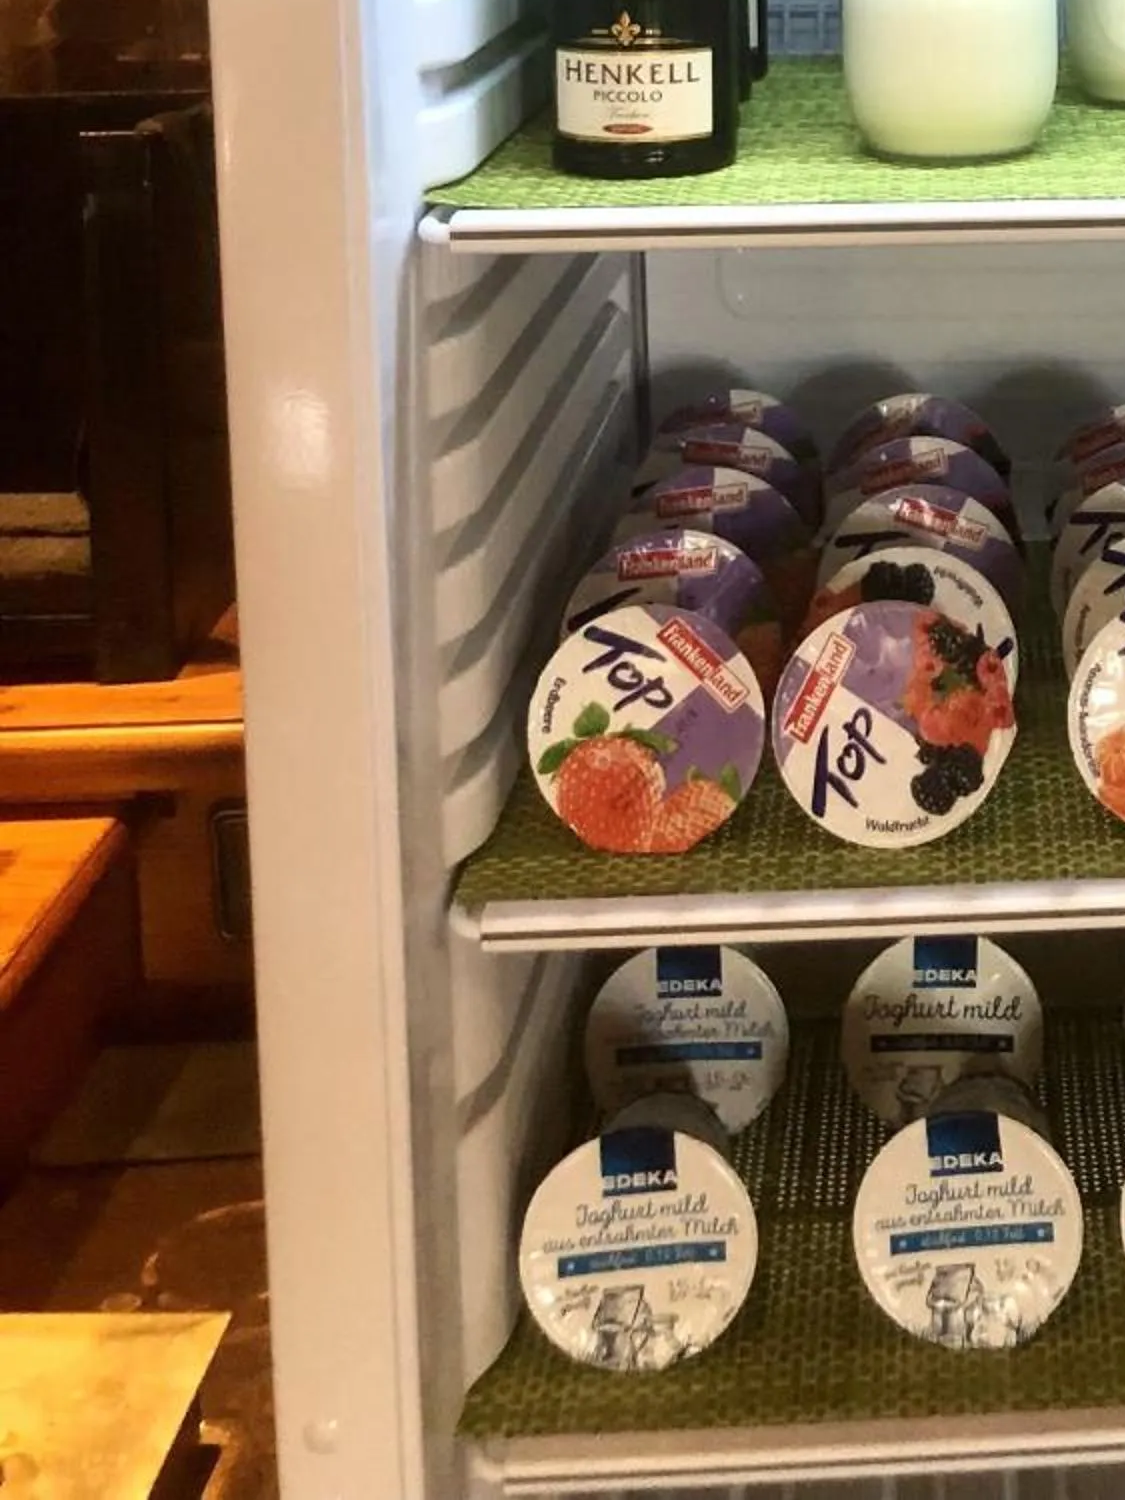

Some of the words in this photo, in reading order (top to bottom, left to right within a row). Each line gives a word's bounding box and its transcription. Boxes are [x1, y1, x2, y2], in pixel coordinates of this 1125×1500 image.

[565, 59, 701, 85] HENKELL
[593, 90, 663, 102] PICCOLO
[582, 625, 674, 712] Top
[661, 623, 744, 704] Frankenland
[789, 640, 848, 742] Frankenland
[812, 707, 886, 818] Top
[657, 978, 722, 993] EDEKA
[914, 969, 977, 982] EDEKA
[863, 993, 960, 1026] Joghurt
[964, 996, 1022, 1021] mild
[930, 1152, 1002, 1169] EDEKA
[602, 1169, 678, 1190] EDEKA
[905, 1178, 984, 1208] Joghurt
[987, 1173, 1033, 1197] mild
[576, 1199, 656, 1228] Joghurt
[660, 1193, 709, 1215] mild
[1009, 1198, 1066, 1218] Milch
[680, 1216, 739, 1237] Milch
